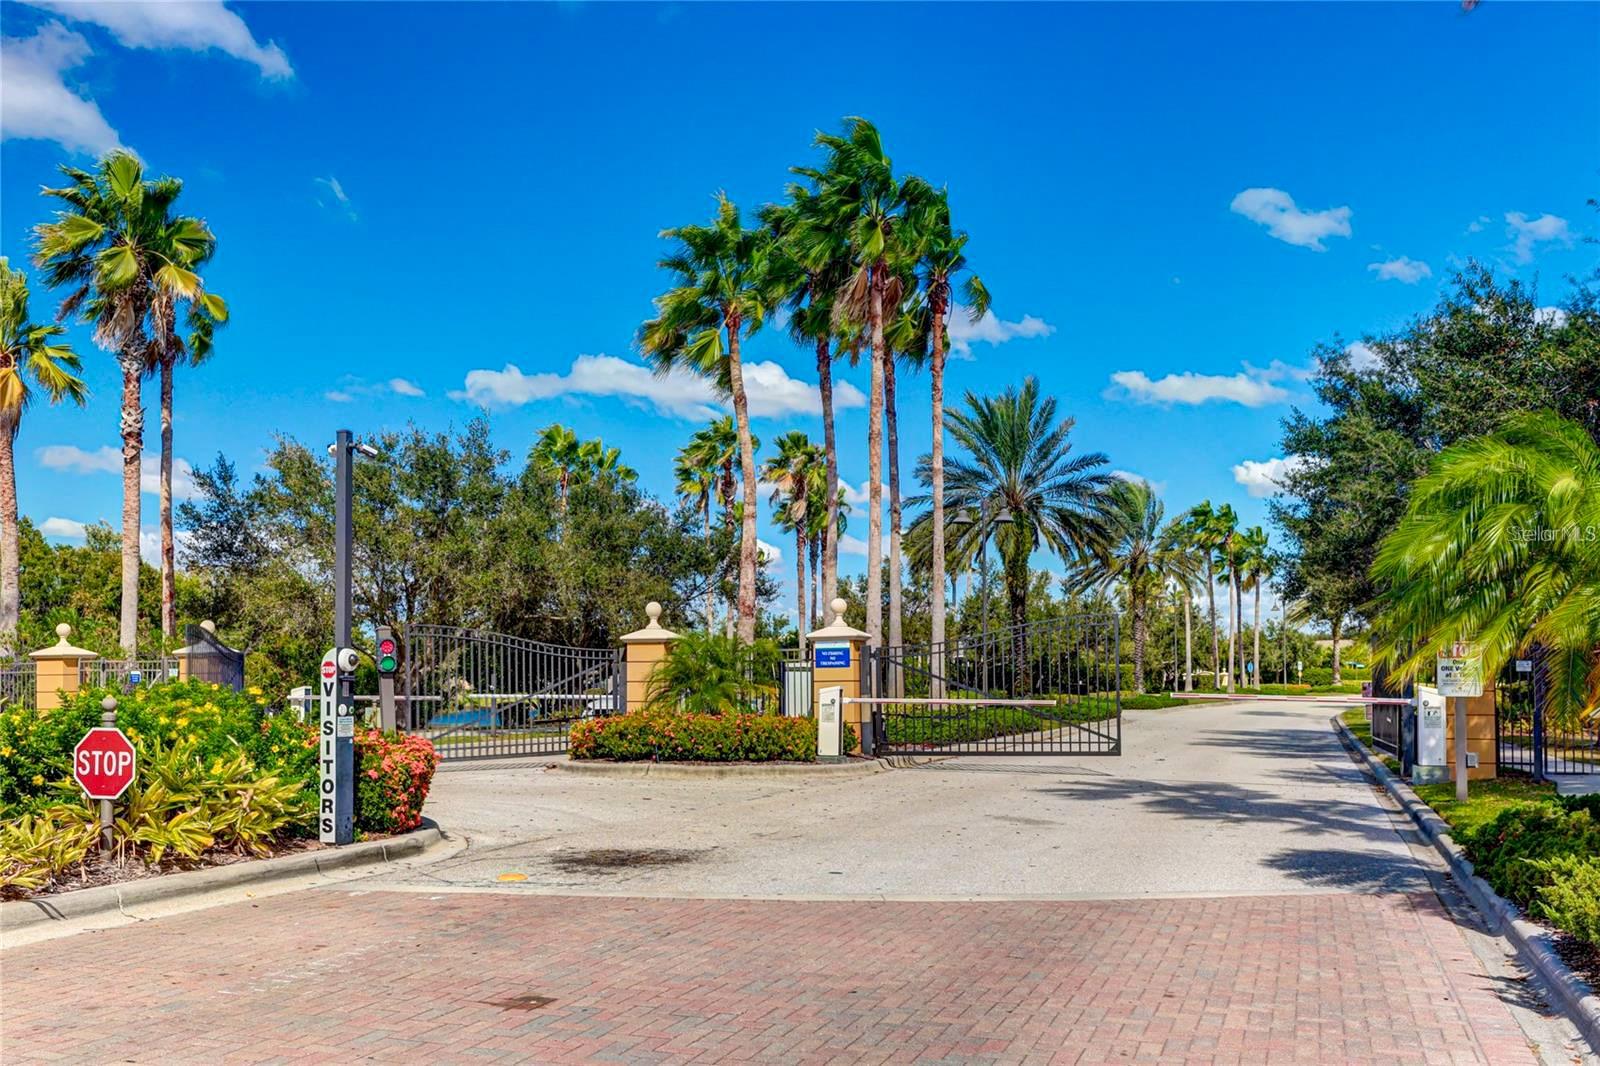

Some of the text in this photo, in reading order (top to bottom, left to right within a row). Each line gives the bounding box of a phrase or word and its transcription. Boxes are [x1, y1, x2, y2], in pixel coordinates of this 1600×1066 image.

[321, 666, 336, 674] STOP
[78, 749, 131, 776] STOP
[322, 682, 335, 834] VISITORS
